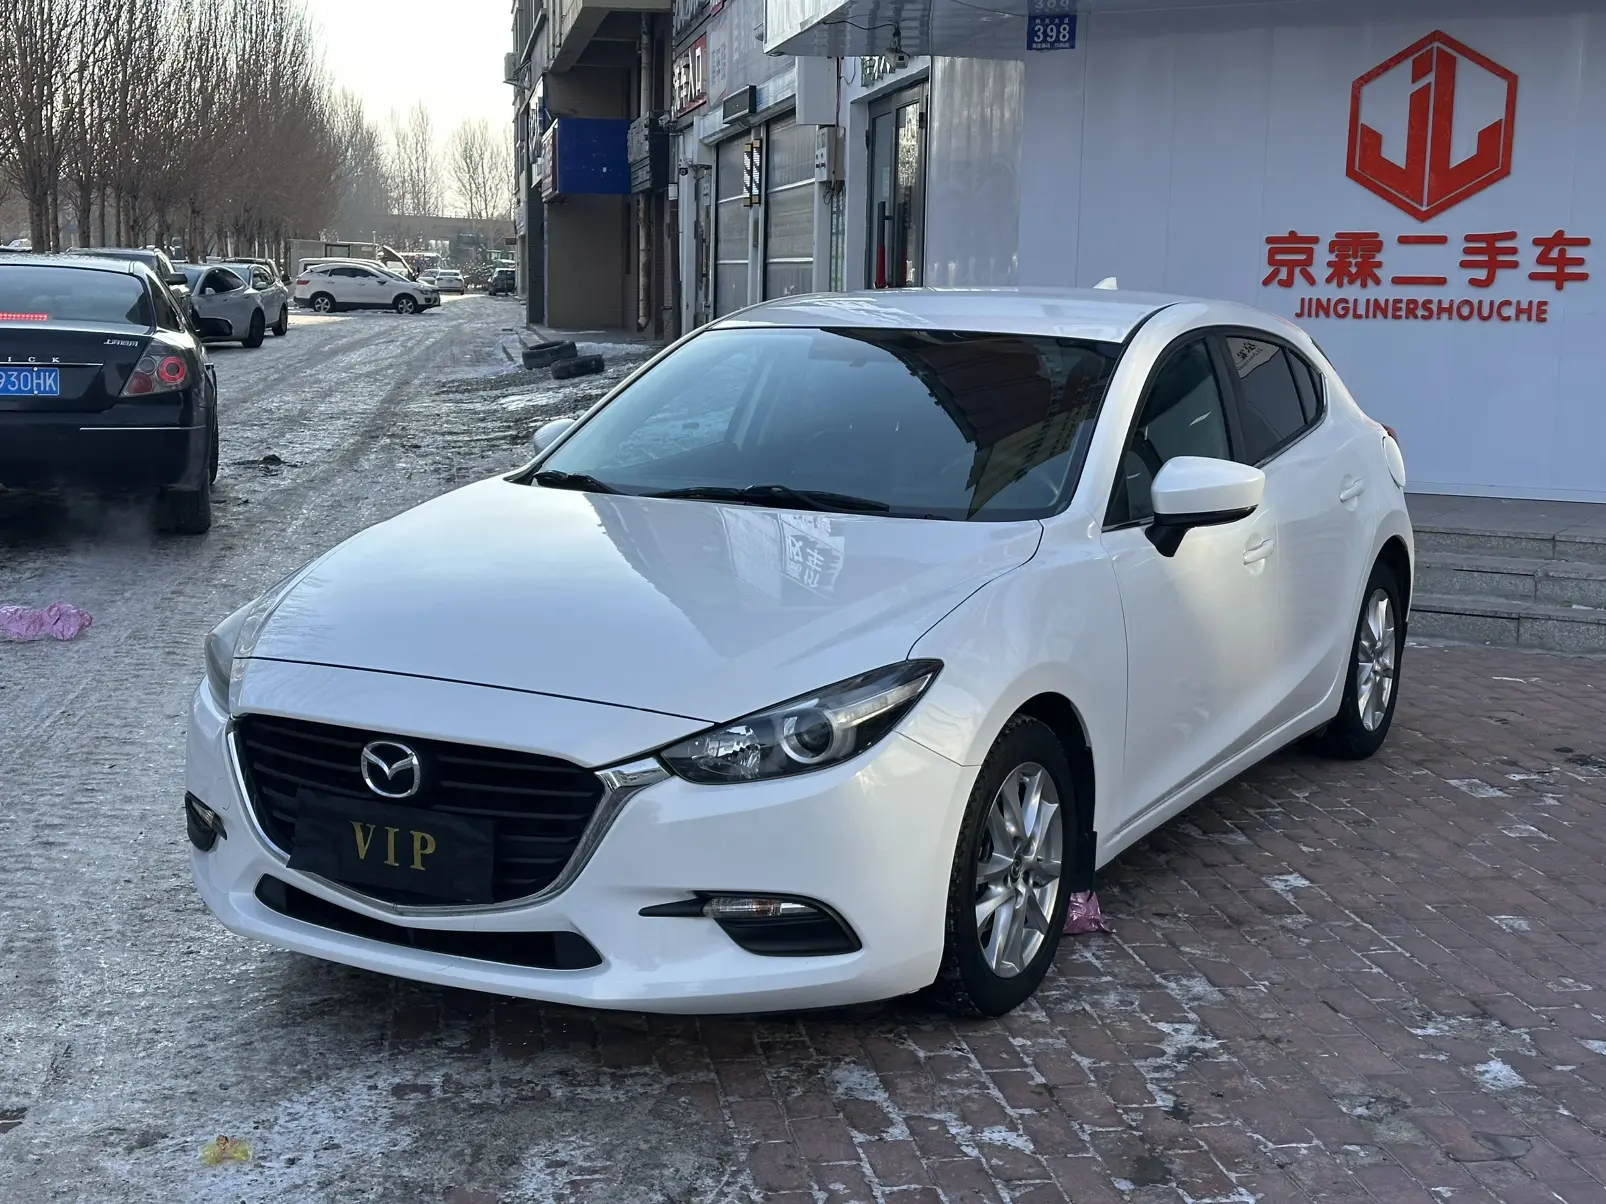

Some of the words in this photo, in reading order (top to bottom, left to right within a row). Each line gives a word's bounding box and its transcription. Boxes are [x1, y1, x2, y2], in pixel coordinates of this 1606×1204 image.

[1033, 24, 1070, 42] 398
[1262, 230, 1592, 290] 京霖二手车
[1295, 297, 1549, 323] JINGLINERSHOUCHE
[349, 820, 436, 871] VIP
